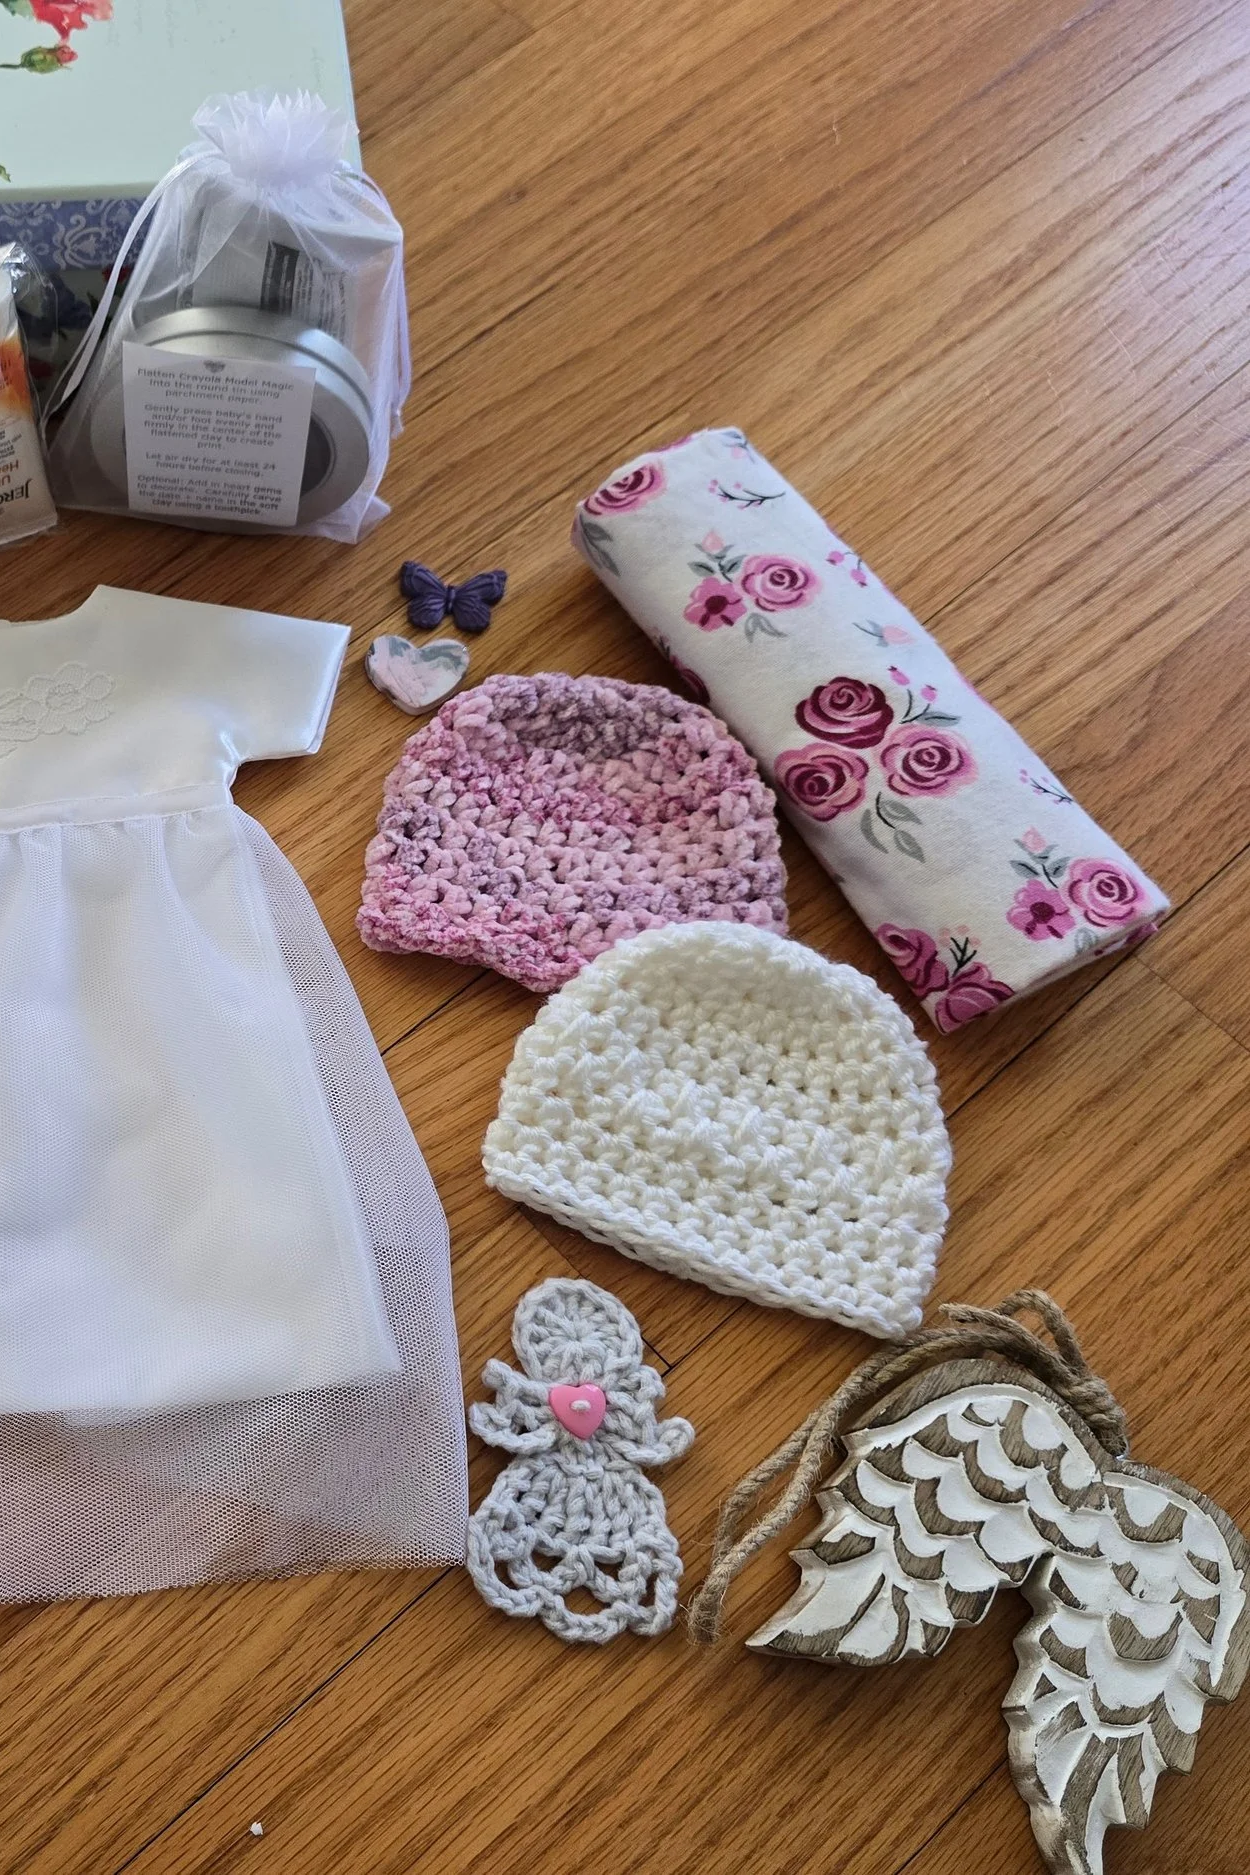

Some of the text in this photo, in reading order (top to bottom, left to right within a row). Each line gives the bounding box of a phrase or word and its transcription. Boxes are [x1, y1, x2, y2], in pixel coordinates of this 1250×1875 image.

[138, 368, 294, 391] Flatten Crayola Model Magic
[150, 380, 279, 399] into the round tin using
[166, 389, 223, 401] parchment
[145, 404, 282, 423] Gently press baby's hand
[152, 414, 275, 430] and/or foot evenly and
